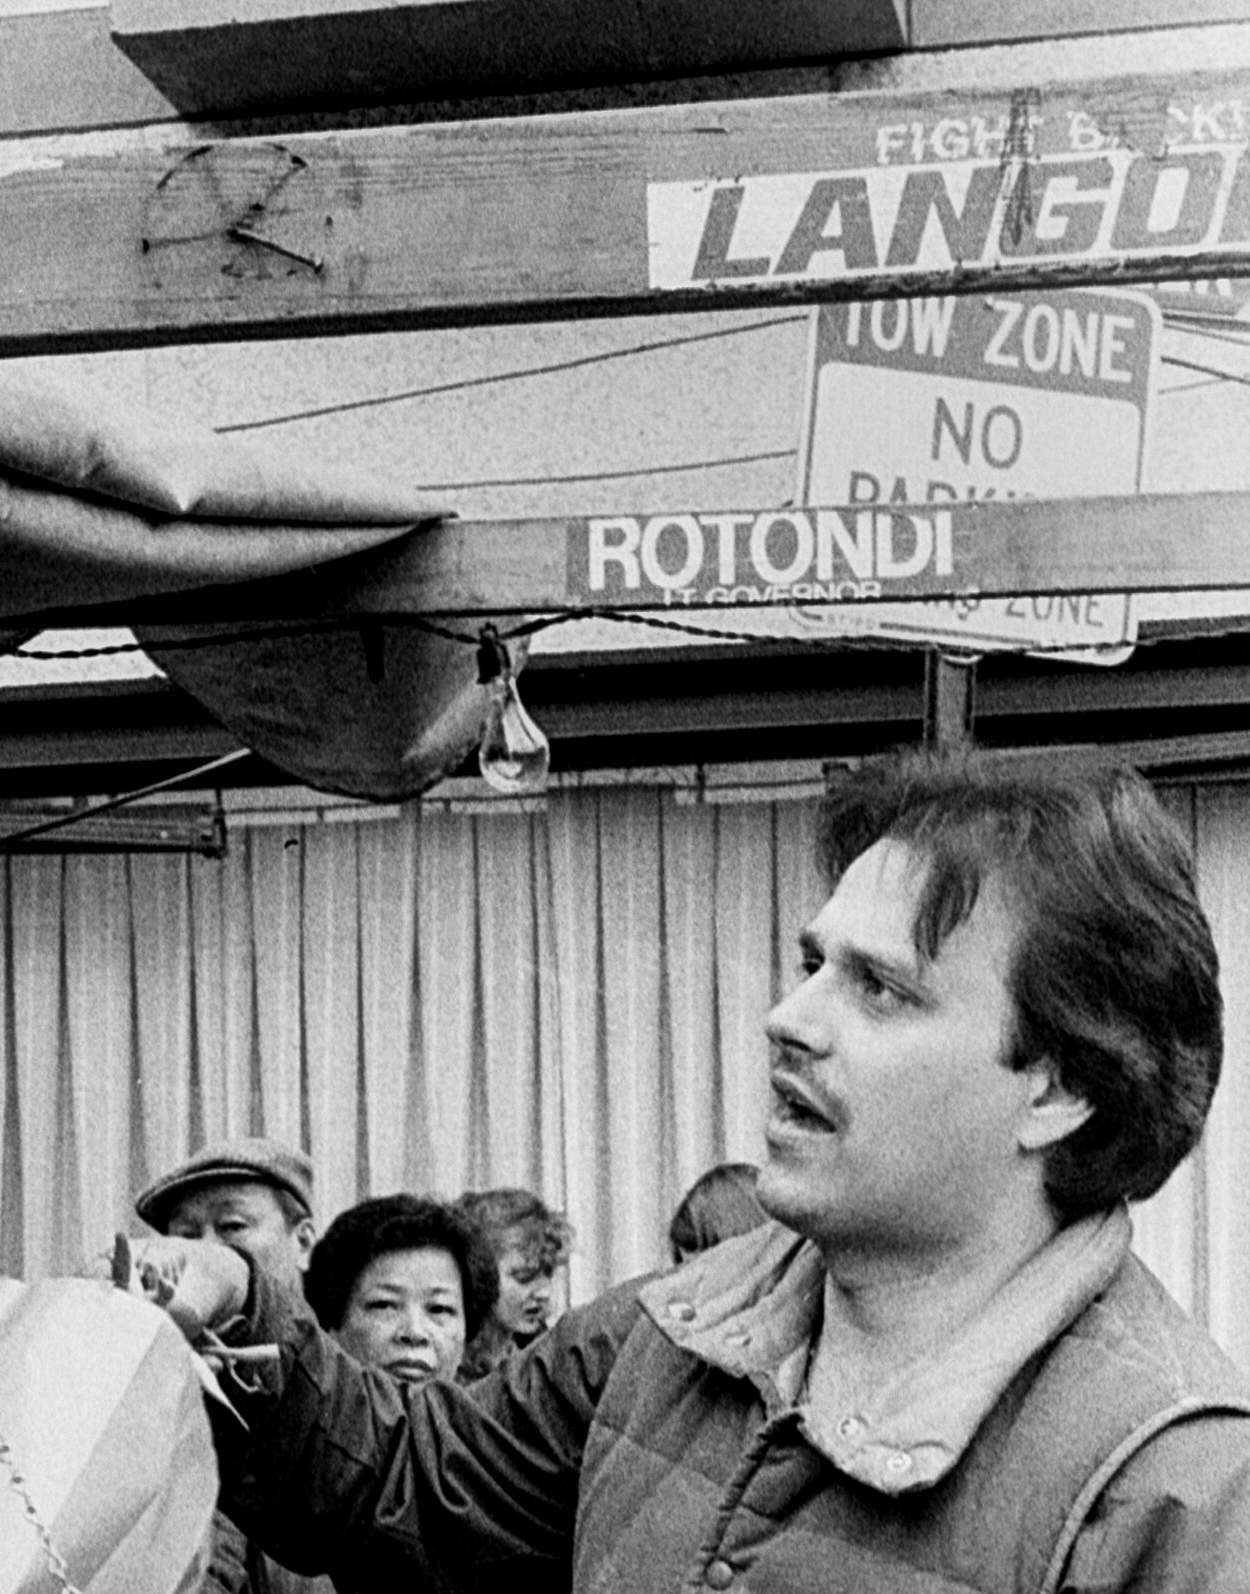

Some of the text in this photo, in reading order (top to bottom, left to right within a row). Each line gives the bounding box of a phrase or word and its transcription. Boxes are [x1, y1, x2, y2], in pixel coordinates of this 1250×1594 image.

[847, 298, 1136, 384] TOW ZONE
[931, 397, 1024, 470] NO
[588, 510, 953, 591] ROTONDI
